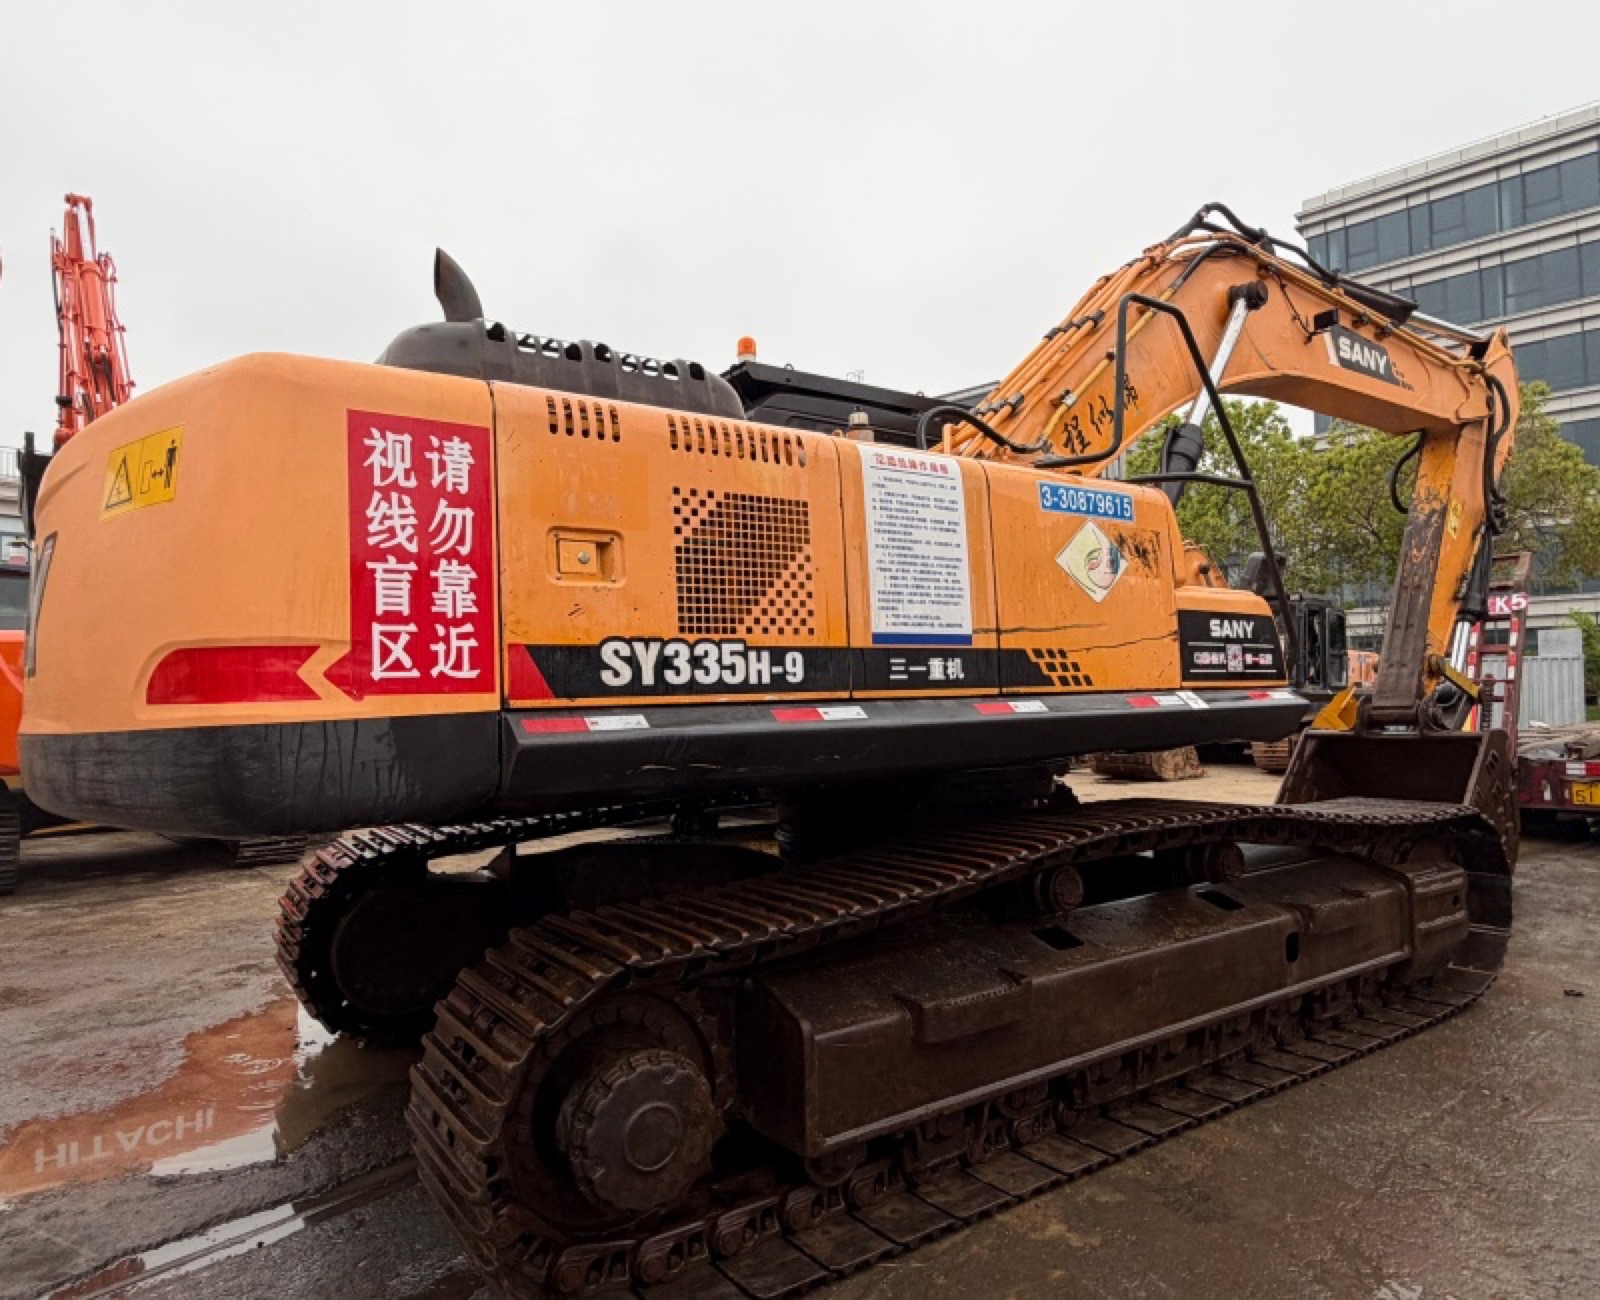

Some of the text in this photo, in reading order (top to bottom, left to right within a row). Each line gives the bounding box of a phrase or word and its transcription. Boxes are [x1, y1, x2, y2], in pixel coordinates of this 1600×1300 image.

[1338, 335, 1388, 375] SANY
[363, 427, 421, 682] 视线盲区
[424, 434, 481, 679] 请勿靠近
[1495, 592, 1527, 614] K5
[1209, 617, 1255, 639] SANY
[600, 640, 804, 687] SY335H-9
[889, 657, 965, 681] 三一重机
